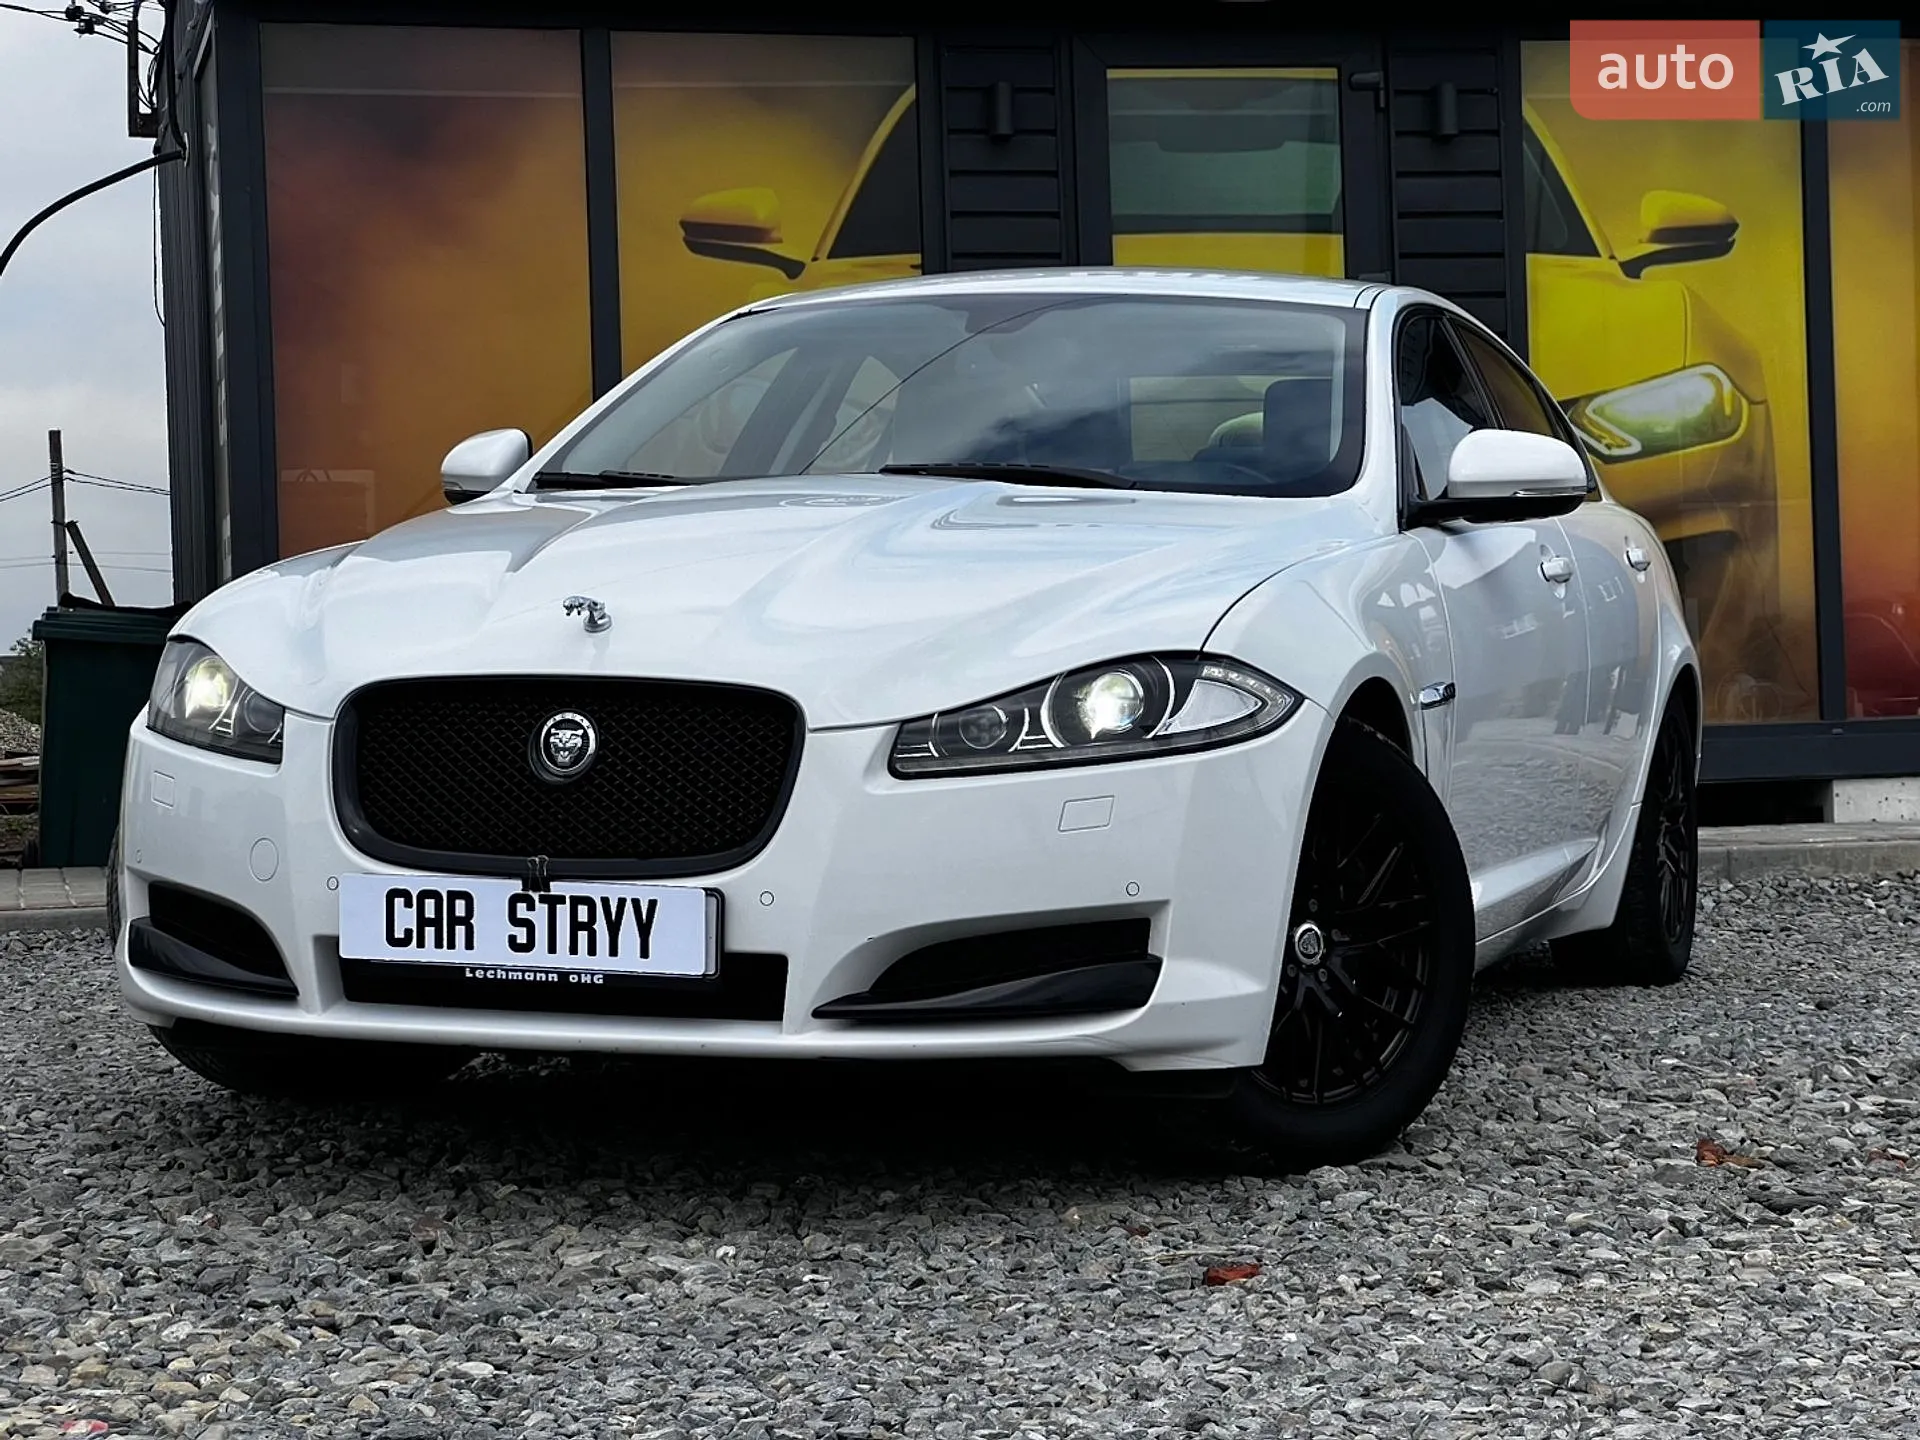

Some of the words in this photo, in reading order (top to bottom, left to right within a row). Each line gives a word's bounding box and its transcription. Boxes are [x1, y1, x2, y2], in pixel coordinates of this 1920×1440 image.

[385, 887, 475, 951] CAR
[507, 892, 659, 960] STRYY
[465, 967, 559, 983] Lechmann
